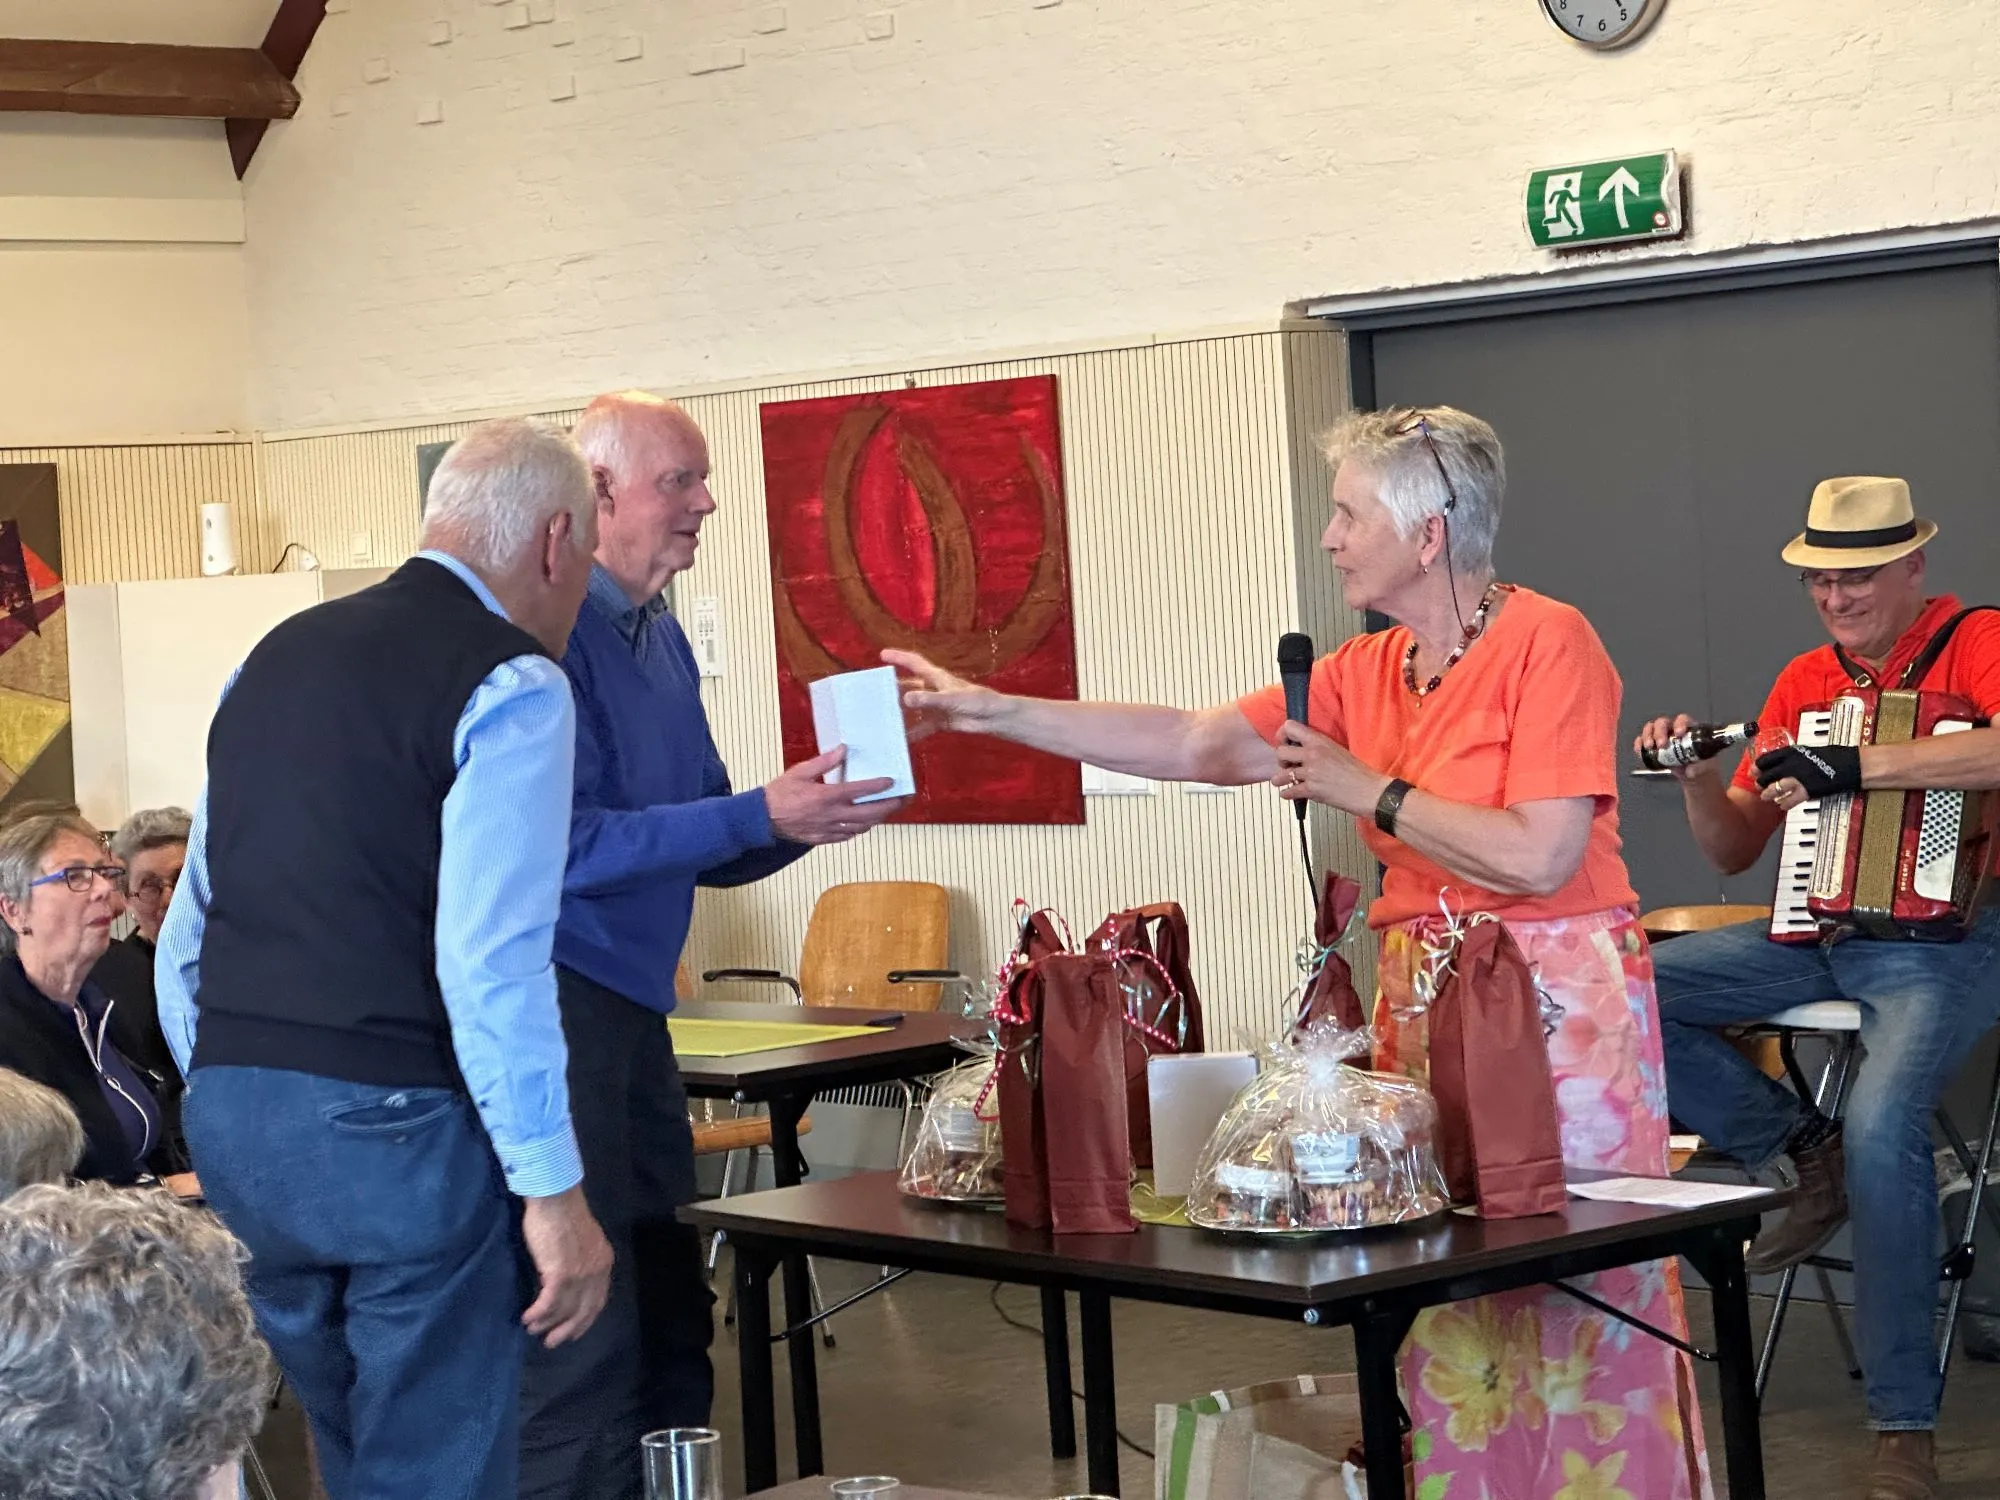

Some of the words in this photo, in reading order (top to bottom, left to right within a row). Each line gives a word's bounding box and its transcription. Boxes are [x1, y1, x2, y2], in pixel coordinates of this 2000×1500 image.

[1560, 0, 1567, 9] 8
[1576, 14, 1584, 27] 7
[1620, 8, 1627, 21] 5
[1598, 19, 1606, 31] 6
